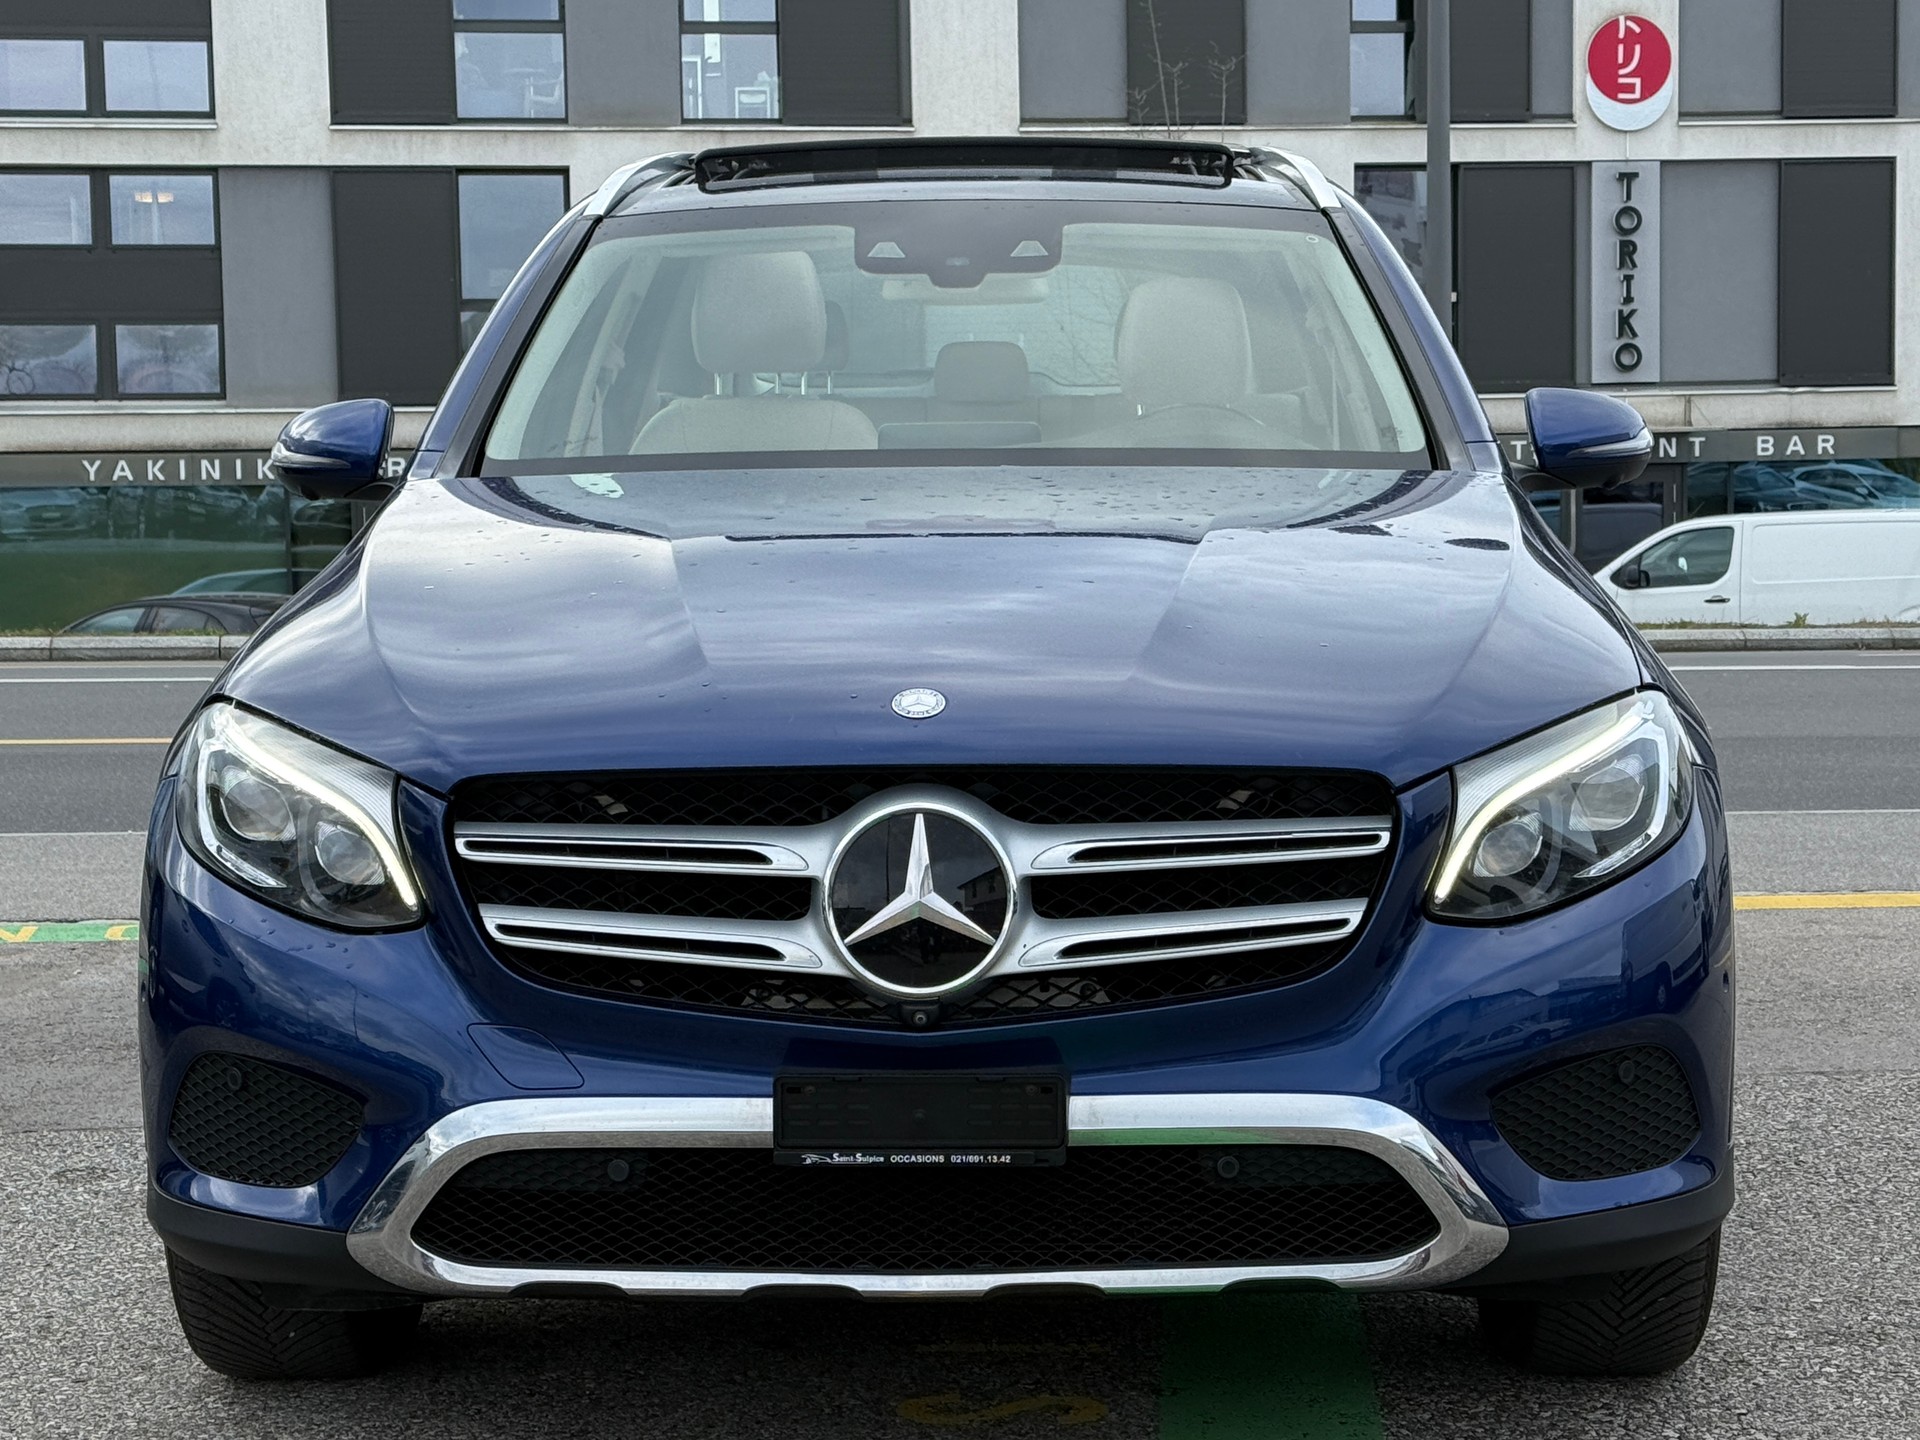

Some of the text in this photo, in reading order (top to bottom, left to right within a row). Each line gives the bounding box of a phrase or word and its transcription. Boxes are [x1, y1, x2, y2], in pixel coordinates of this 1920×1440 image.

[1617, 14, 1642, 100] トリコ
[1613, 171, 1643, 373] TORIKO
[82, 434, 1836, 481] YAKINIK BAR
[890, 1154, 945, 1163] OCCASIONS
